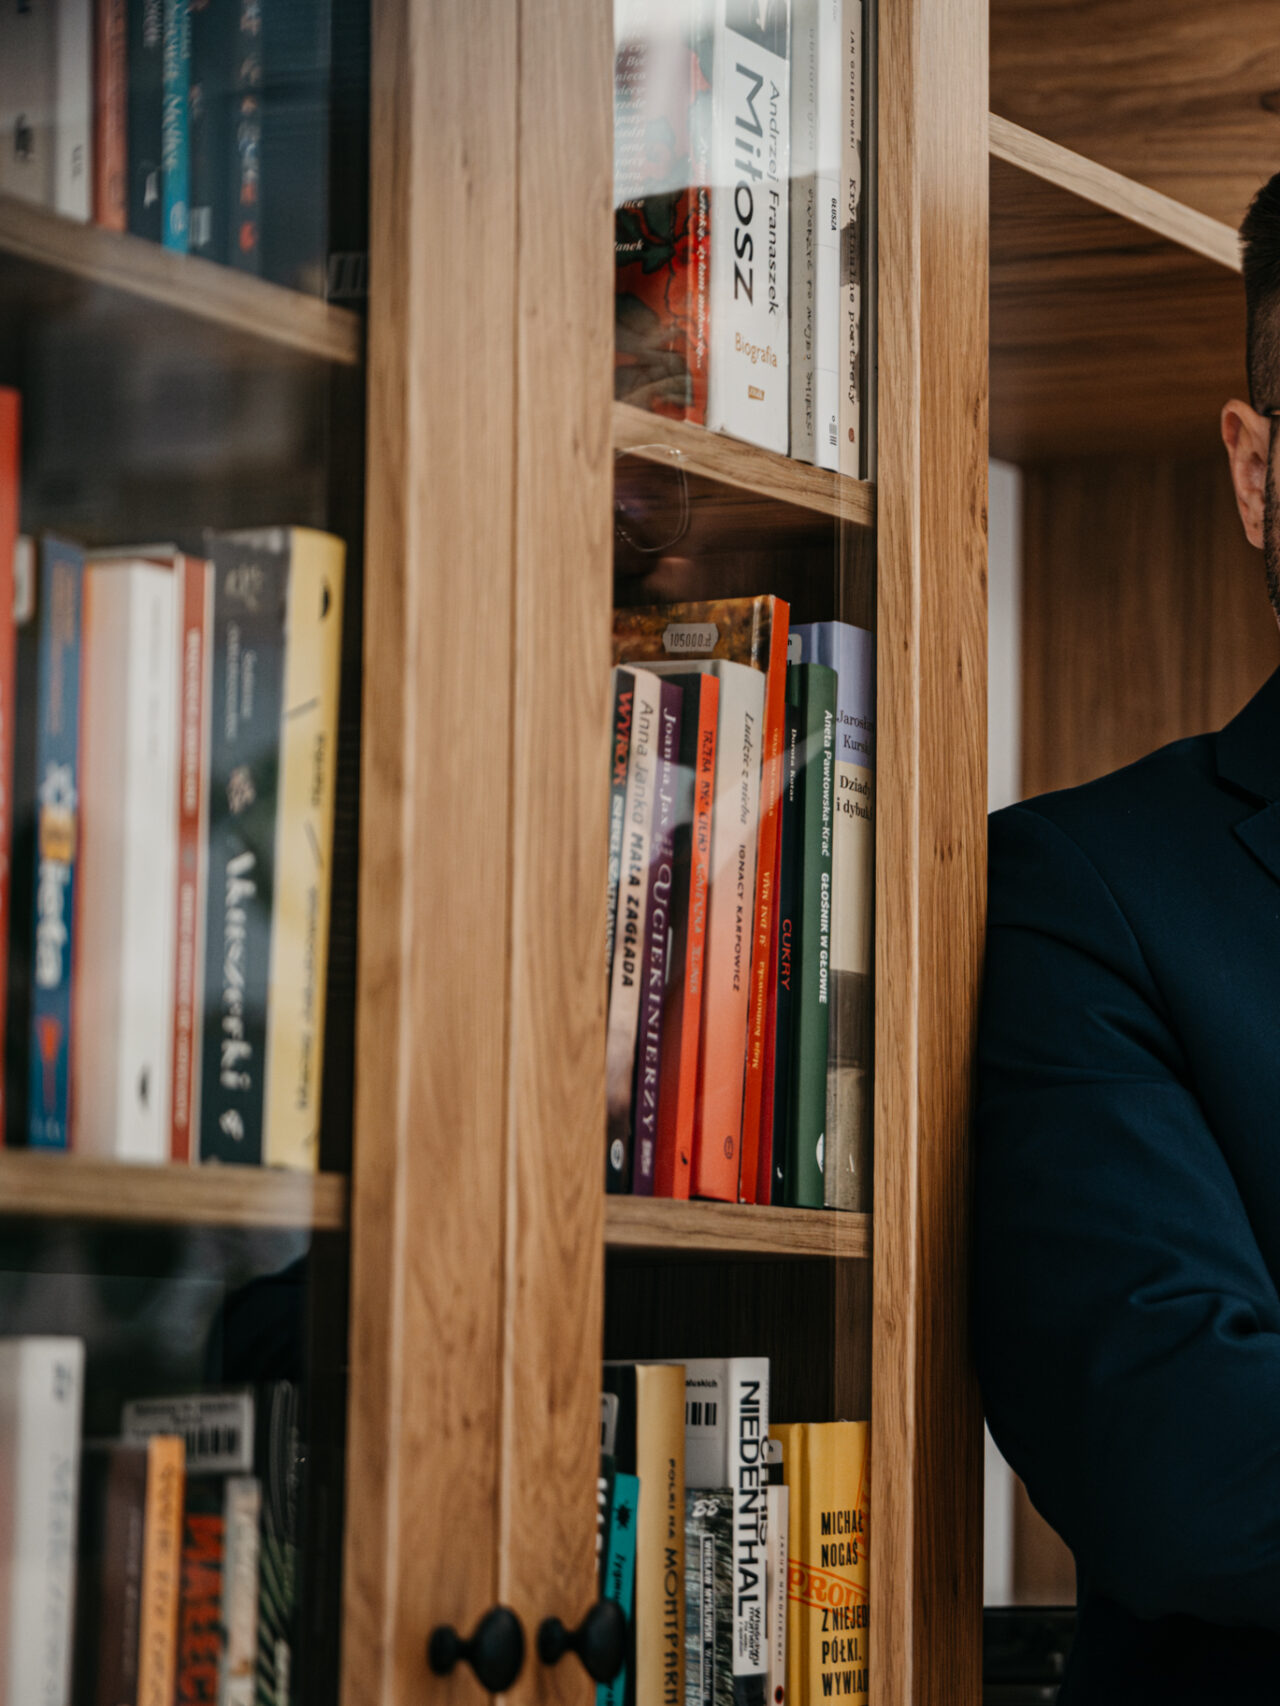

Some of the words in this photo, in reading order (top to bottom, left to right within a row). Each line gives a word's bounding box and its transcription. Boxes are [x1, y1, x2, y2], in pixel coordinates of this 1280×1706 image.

[849, 29, 857, 55] JAN
[767, 81, 780, 183] Andrzej
[735, 62, 764, 306] Miłosz
[767, 190, 780, 315] Franaszek
[846, 178, 859, 302] Kryminalne
[735, 332, 778, 369] Biografia
[846, 310, 858, 405] portrety
[613, 692, 633, 786] WYROK
[637, 699, 655, 756] Anna
[660, 707, 677, 785] Joanna
[740, 712, 755, 767] Ludzie
[789, 728, 798, 767] Dorota
[821, 709, 834, 748] Aneta
[836, 709, 874, 732] Jarosła
[631, 764, 649, 824] Janko
[659, 787, 673, 826] Jax
[739, 781, 751, 825] nieba
[788, 769, 797, 802] Kotas
[820, 750, 833, 857] Pawłowska-Krać
[836, 797, 842, 812] i
[627, 831, 646, 886] MAŁA
[736, 844, 747, 900] IGNACY
[818, 872, 831, 933] GŁOŚNIK
[621, 894, 641, 987] ZAGŁADA
[732, 905, 745, 992] KARPOWICZ
[781, 918, 794, 991] CUKRY
[819, 935, 830, 948] W
[643, 864, 673, 1133] UCIEKINIERZY
[818, 950, 830, 1004] GŁOWIE
[738, 1380, 761, 1617] NIEDENTHAL
[821, 1509, 864, 1536] MICHAŁ
[667, 1514, 677, 1539] NA
[821, 1537, 859, 1568] NOGAŚ
[821, 1608, 829, 1632] Z
[822, 1636, 862, 1664] PÓŁKI.
